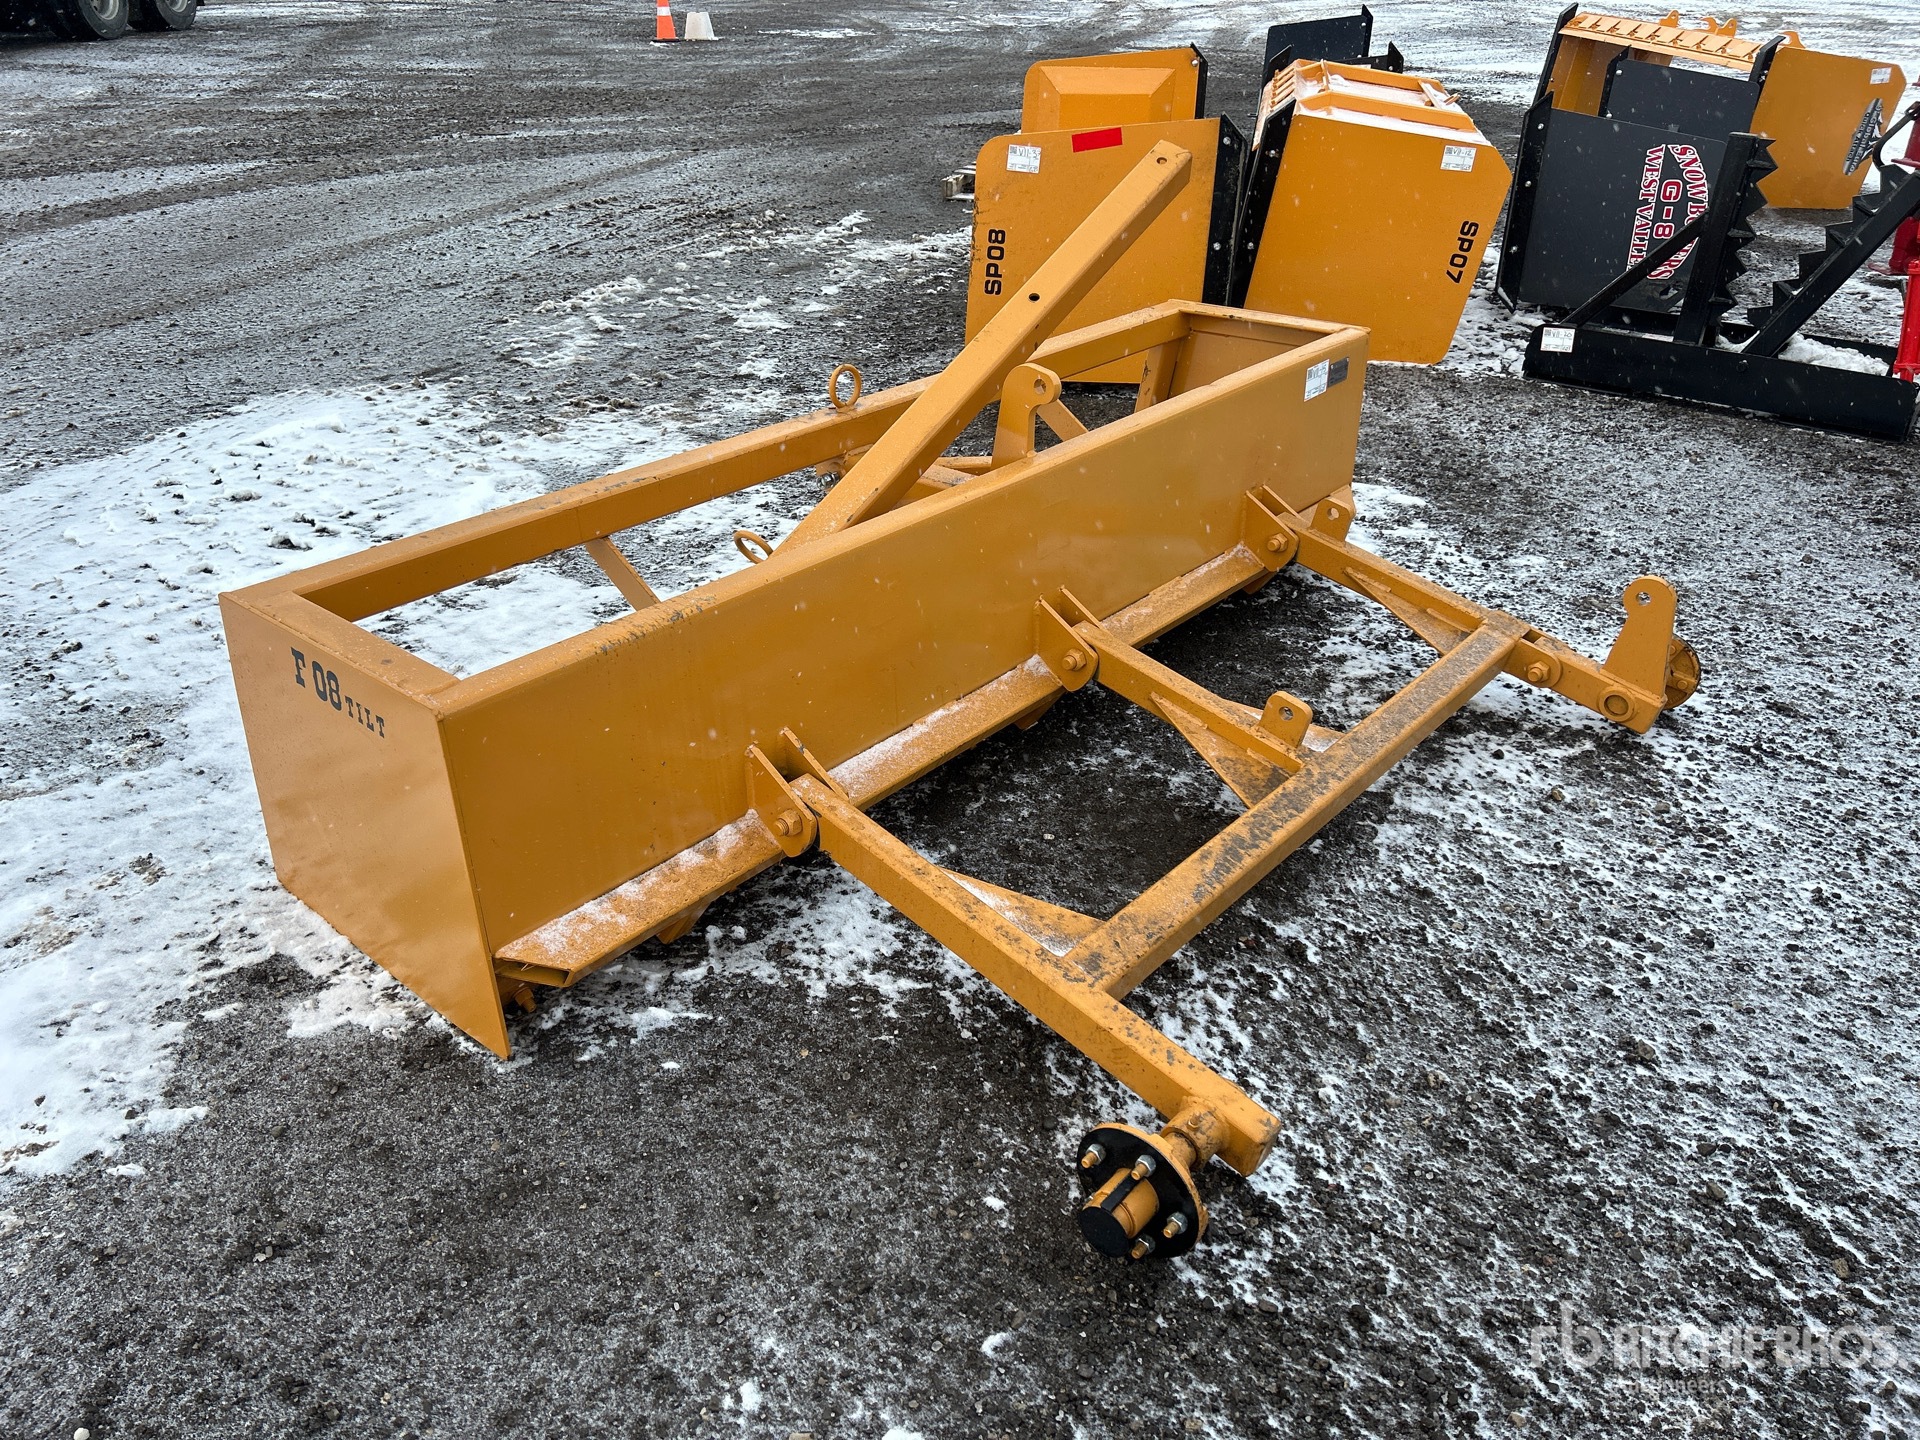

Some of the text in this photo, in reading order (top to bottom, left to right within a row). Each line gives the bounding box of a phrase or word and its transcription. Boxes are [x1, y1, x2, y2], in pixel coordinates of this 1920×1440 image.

[1846, 134, 1862, 162] Attach
[1849, 149, 1864, 173] Euro
[1860, 114, 1878, 149] Global
[1667, 144, 1709, 203] SNOW
[1626, 144, 1666, 272] WEST VALLE
[984, 228, 1006, 296] SP08
[1446, 221, 1479, 284] SP07
[290, 646, 386, 739] F 08 TILT
